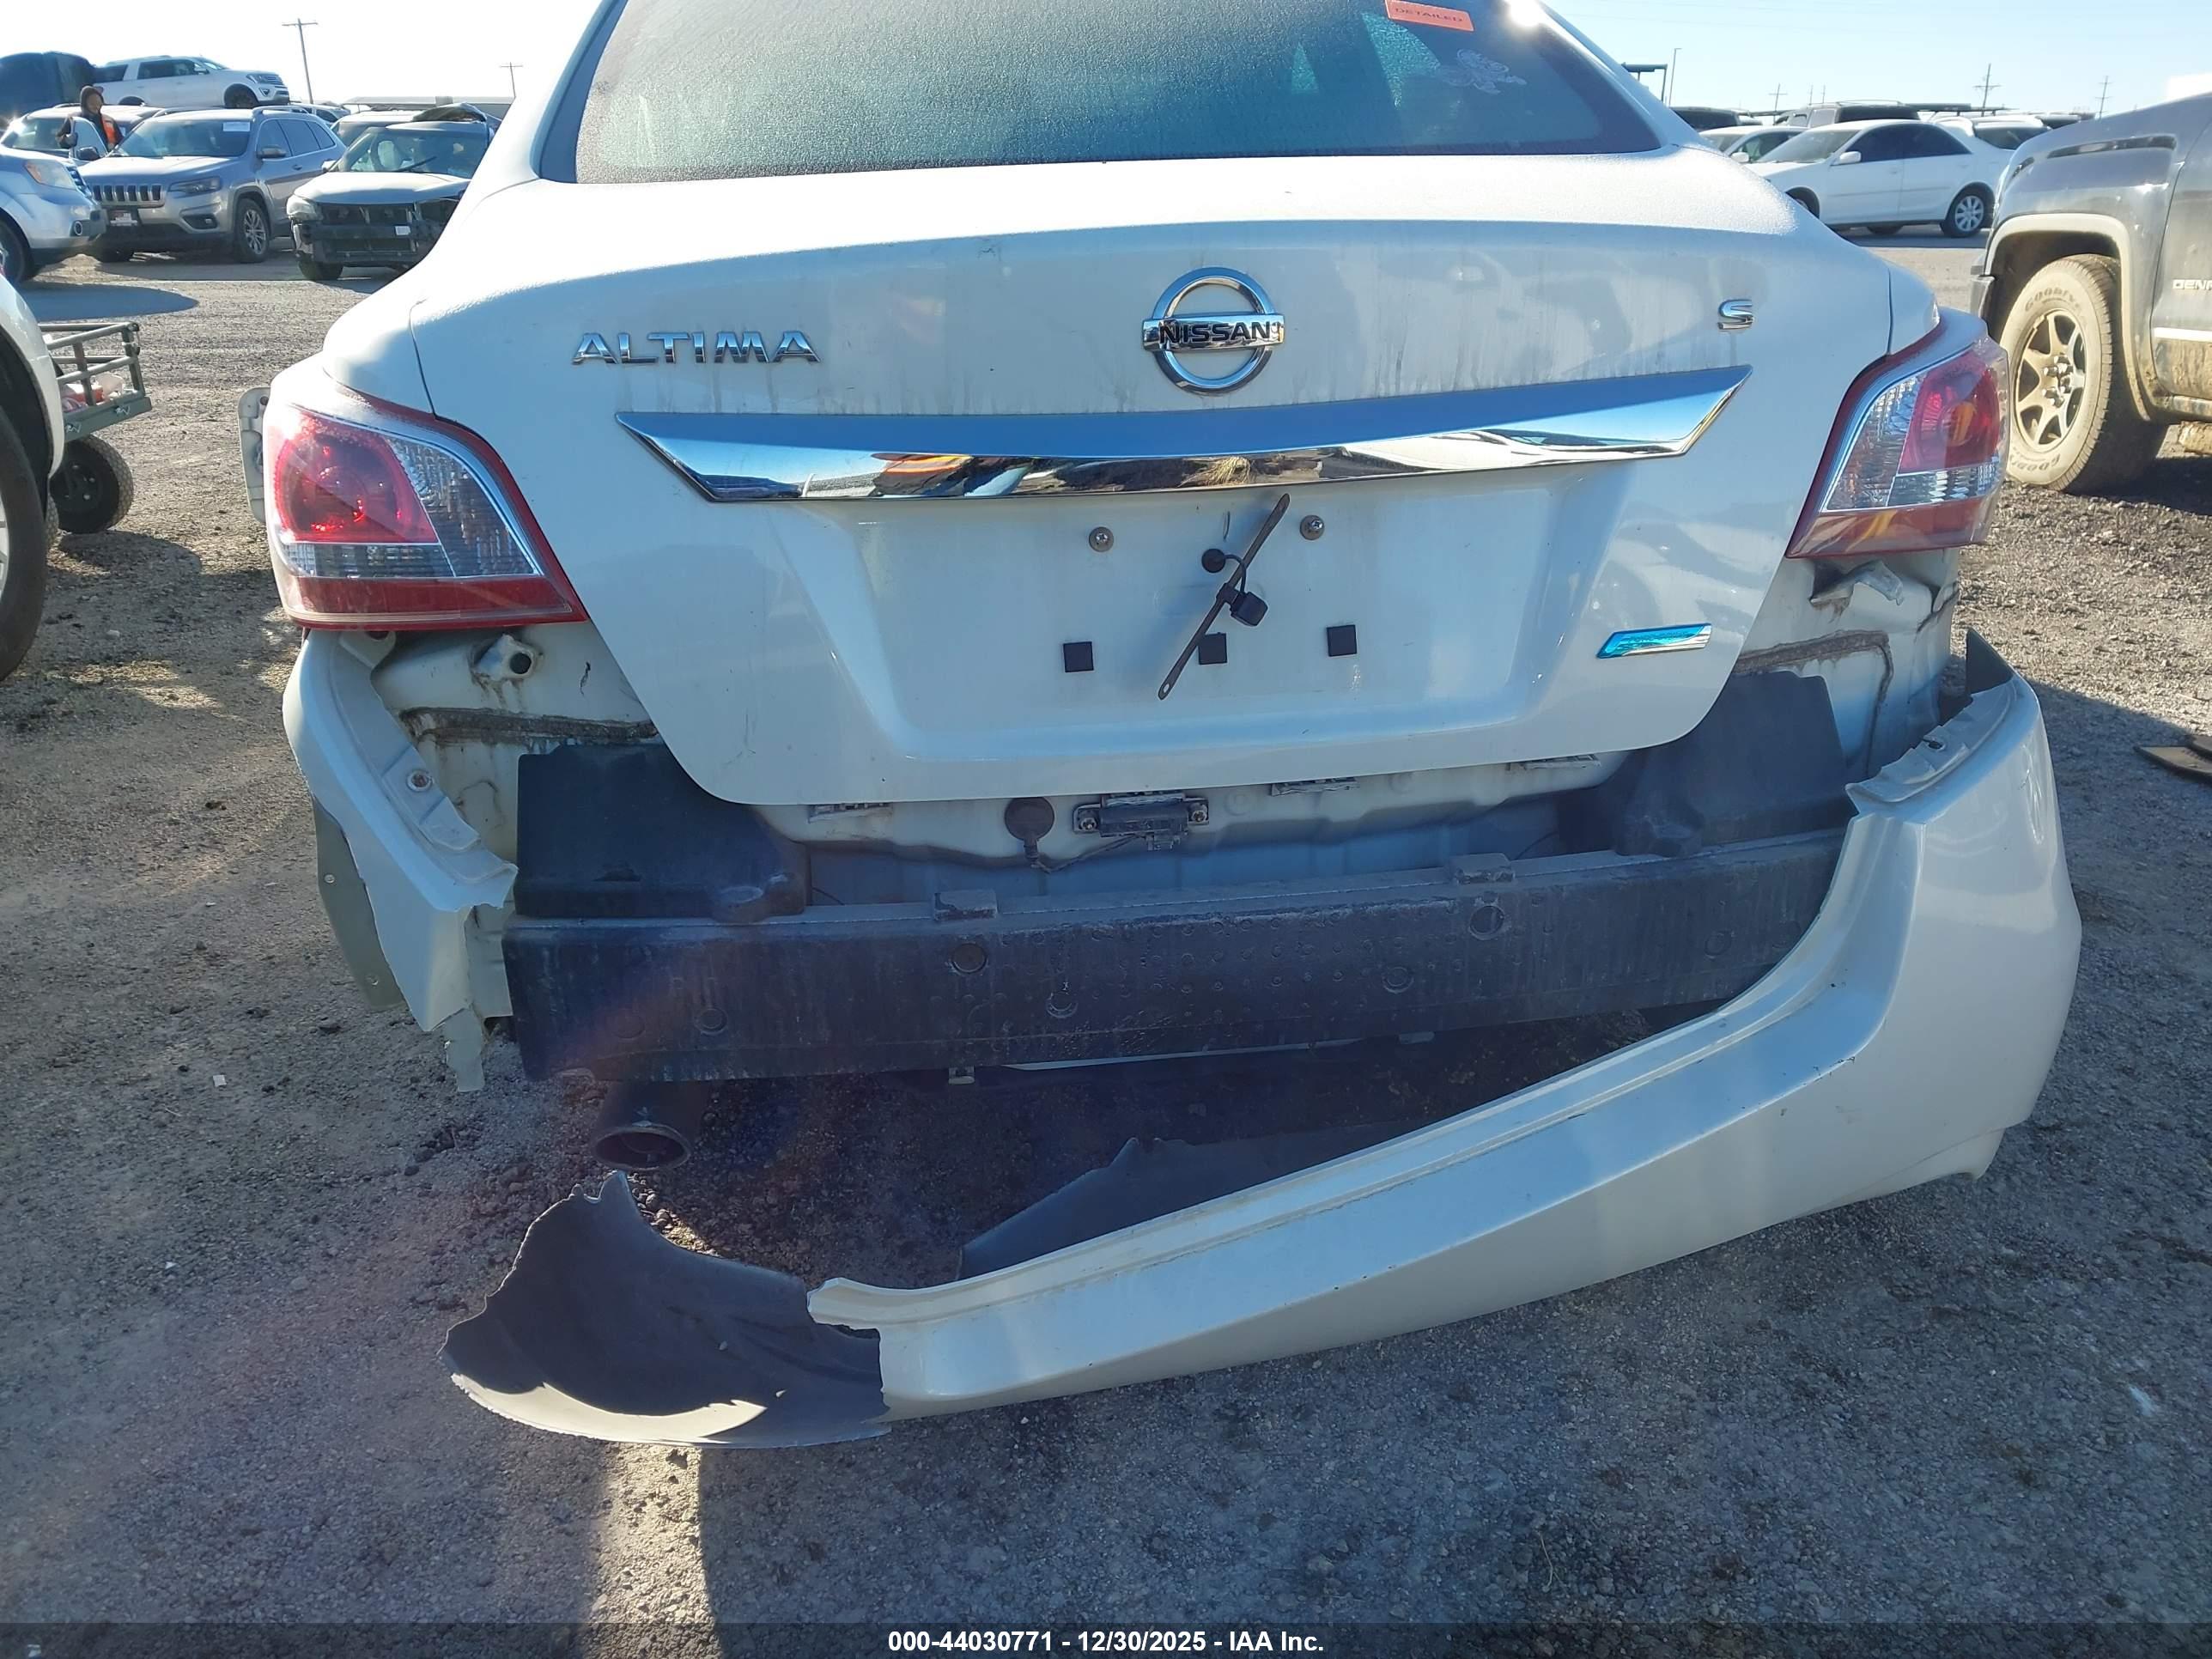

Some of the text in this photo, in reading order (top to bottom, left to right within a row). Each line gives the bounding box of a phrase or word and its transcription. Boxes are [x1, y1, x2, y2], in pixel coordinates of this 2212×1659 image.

[1395, 8, 1463, 21] DETAILED
[1717, 299, 1754, 331] S
[1158, 319, 1272, 344] NISSAN
[571, 331, 822, 365] ALTIMA
